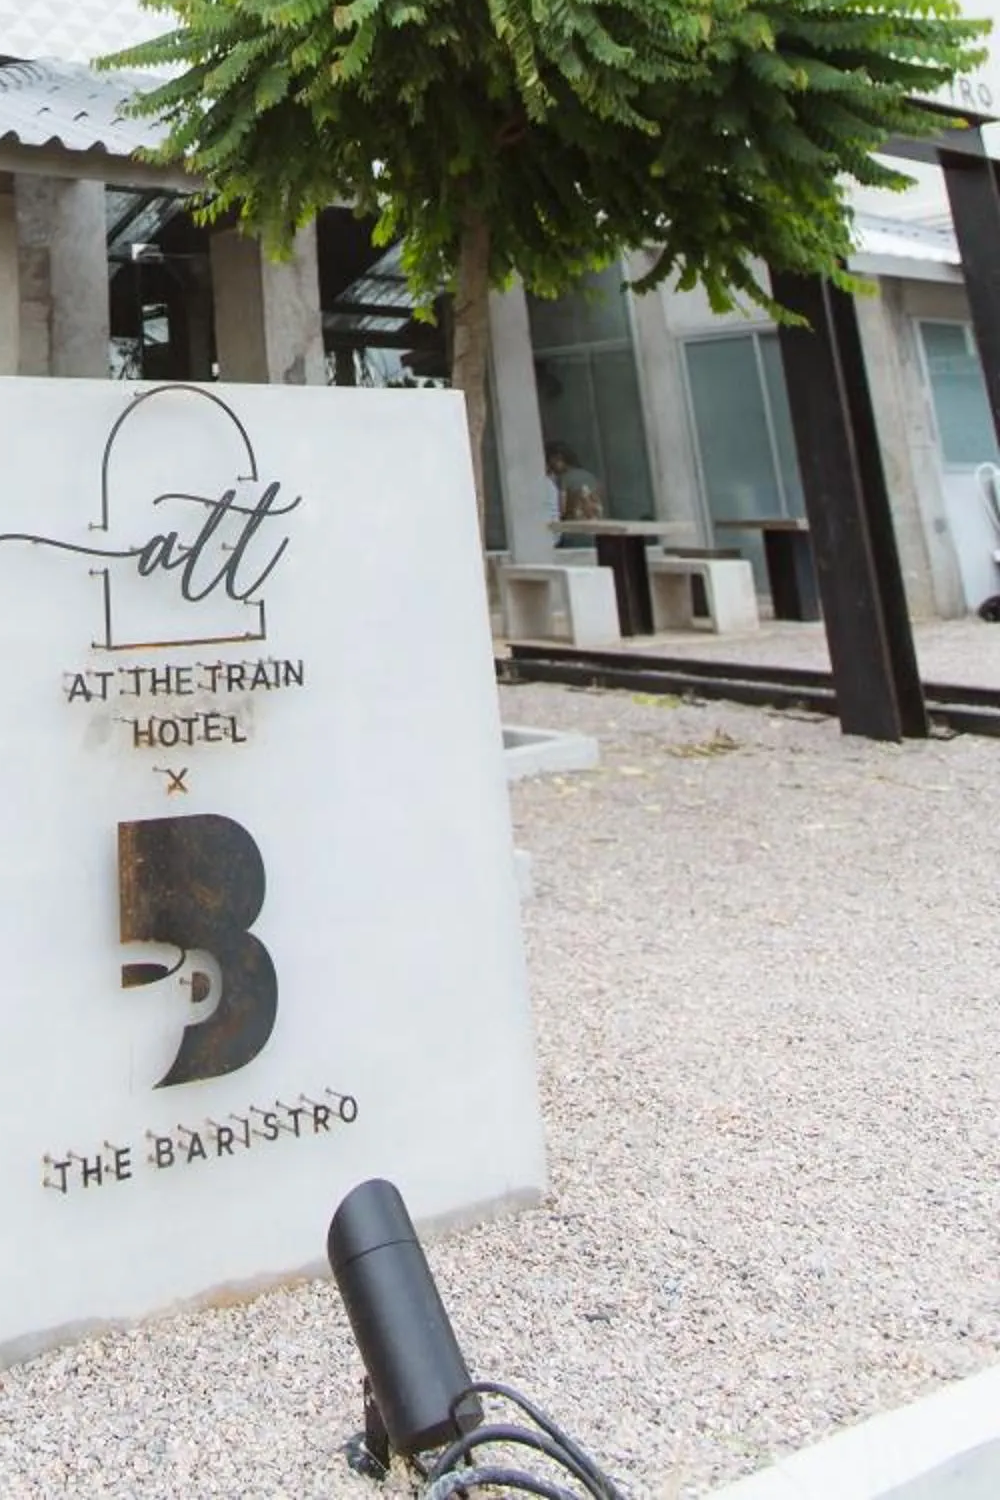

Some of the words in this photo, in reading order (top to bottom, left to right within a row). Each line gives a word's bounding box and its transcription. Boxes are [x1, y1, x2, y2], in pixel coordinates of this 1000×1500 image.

[67, 672, 115, 703] AT
[127, 665, 194, 698] THE
[203, 658, 305, 694] TRAIN
[132, 712, 248, 749] HOTEL
[53, 1147, 132, 1194] THE
[155, 1094, 359, 1169] BARISTRO
